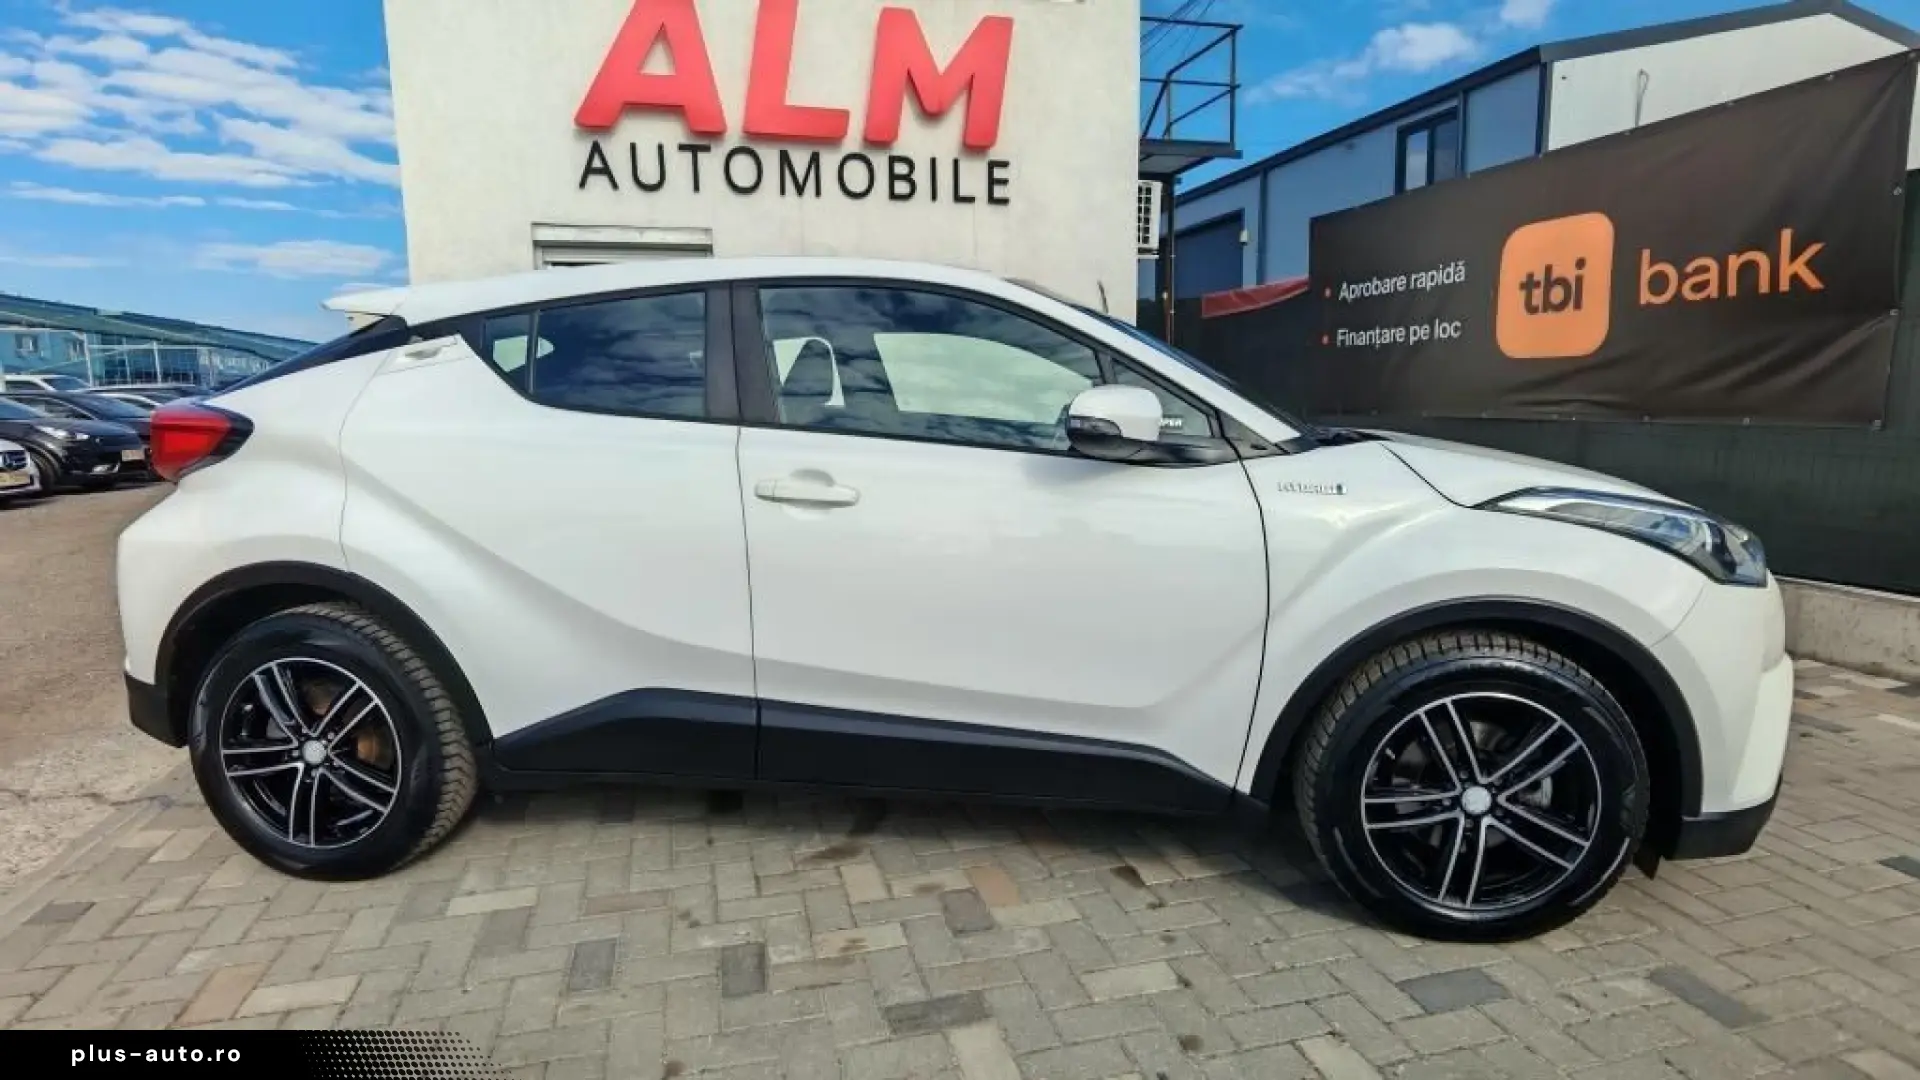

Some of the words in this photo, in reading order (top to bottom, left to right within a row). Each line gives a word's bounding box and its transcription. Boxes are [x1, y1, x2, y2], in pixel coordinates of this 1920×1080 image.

[573, 0, 1015, 150] ALM
[579, 140, 1011, 206] AUTOMOBILE
[1338, 275, 1407, 303] Aprobare
[1409, 260, 1466, 292] rapidă
[1519, 256, 1587, 316] tbi
[1639, 228, 1826, 306] bank
[1336, 325, 1405, 351] Finanțare
[1409, 323, 1431, 346] pe
[1433, 318, 1463, 341] loc
